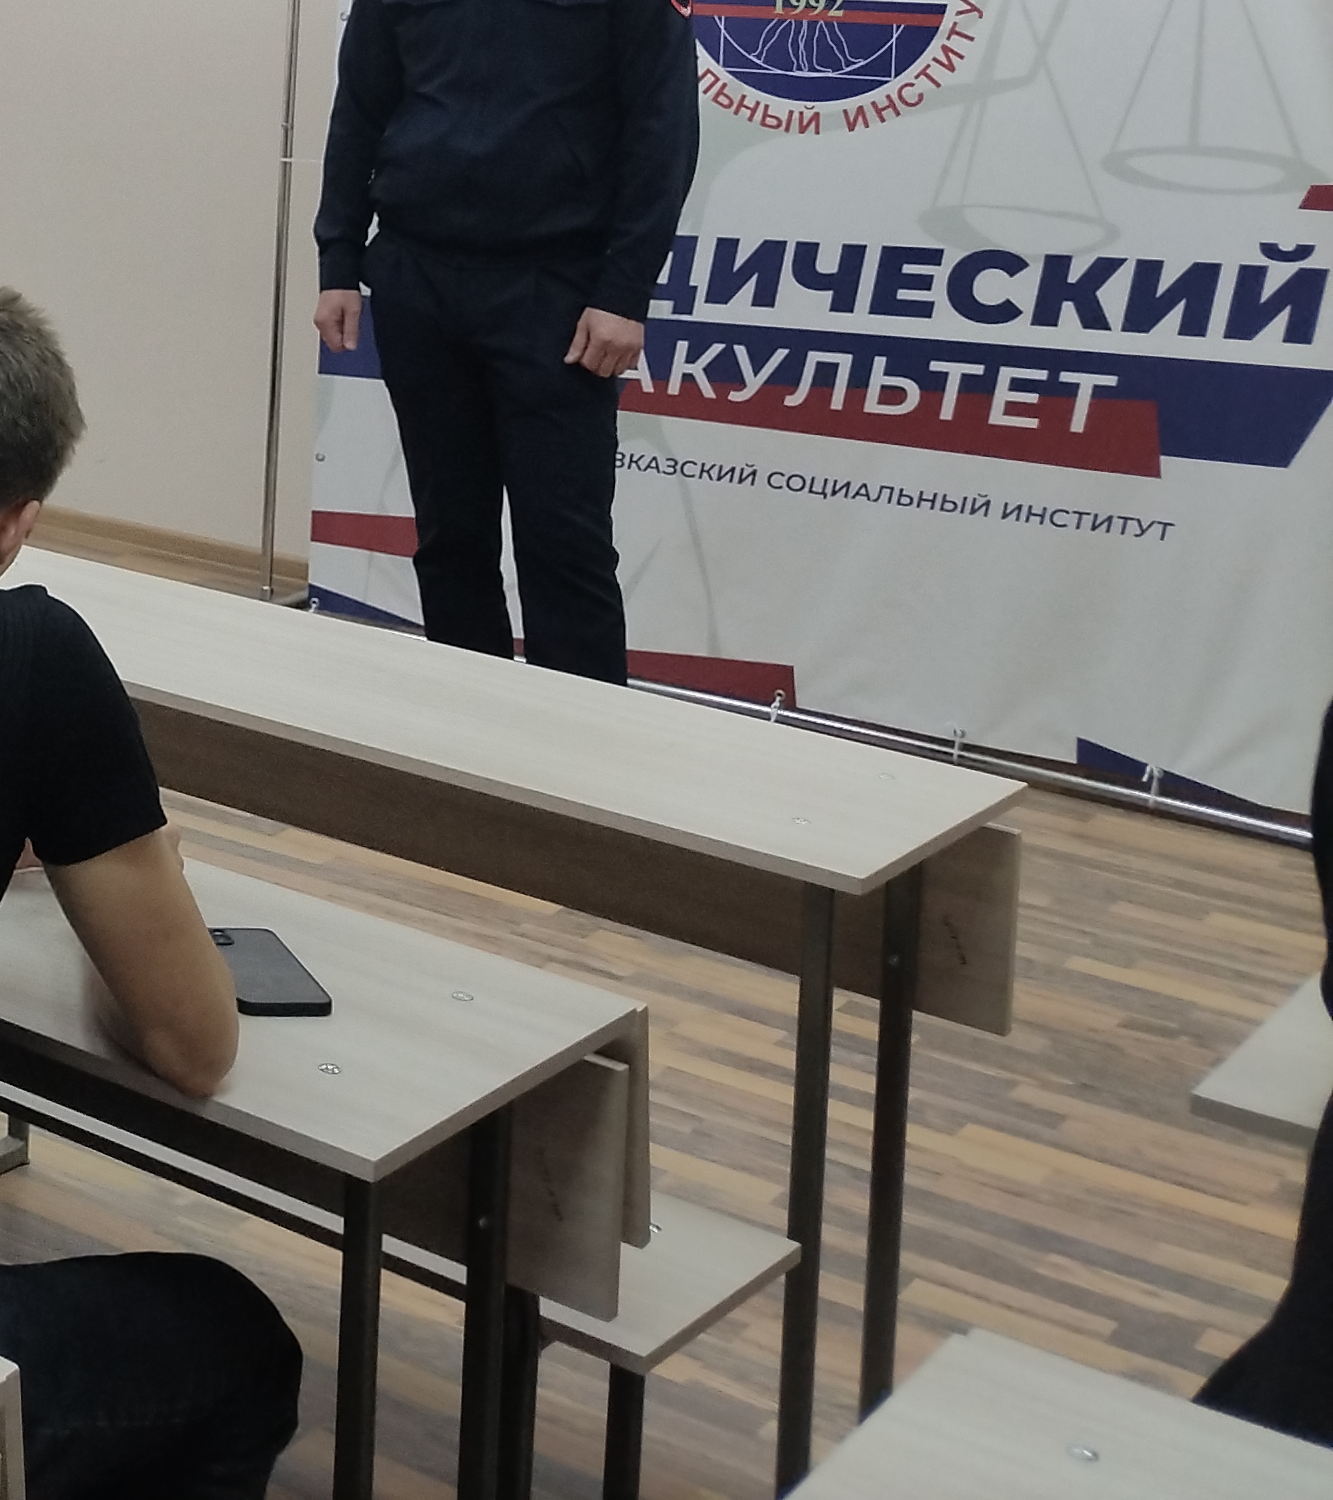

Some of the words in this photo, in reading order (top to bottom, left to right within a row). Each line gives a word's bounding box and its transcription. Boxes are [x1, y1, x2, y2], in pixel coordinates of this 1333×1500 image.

[697, 67, 821, 135] ЛЬНЫЙ
[646, 234, 1331, 346] ДИЧЕСКИЙ
[619, 340, 1118, 435] АКУЛЬТЕТ
[614, 450, 757, 488] ВКАЗСКИЙ
[766, 470, 991, 519] СОЦИАЛЬНЫЙ
[1000, 500, 1176, 543] ИНСТИТУТ
